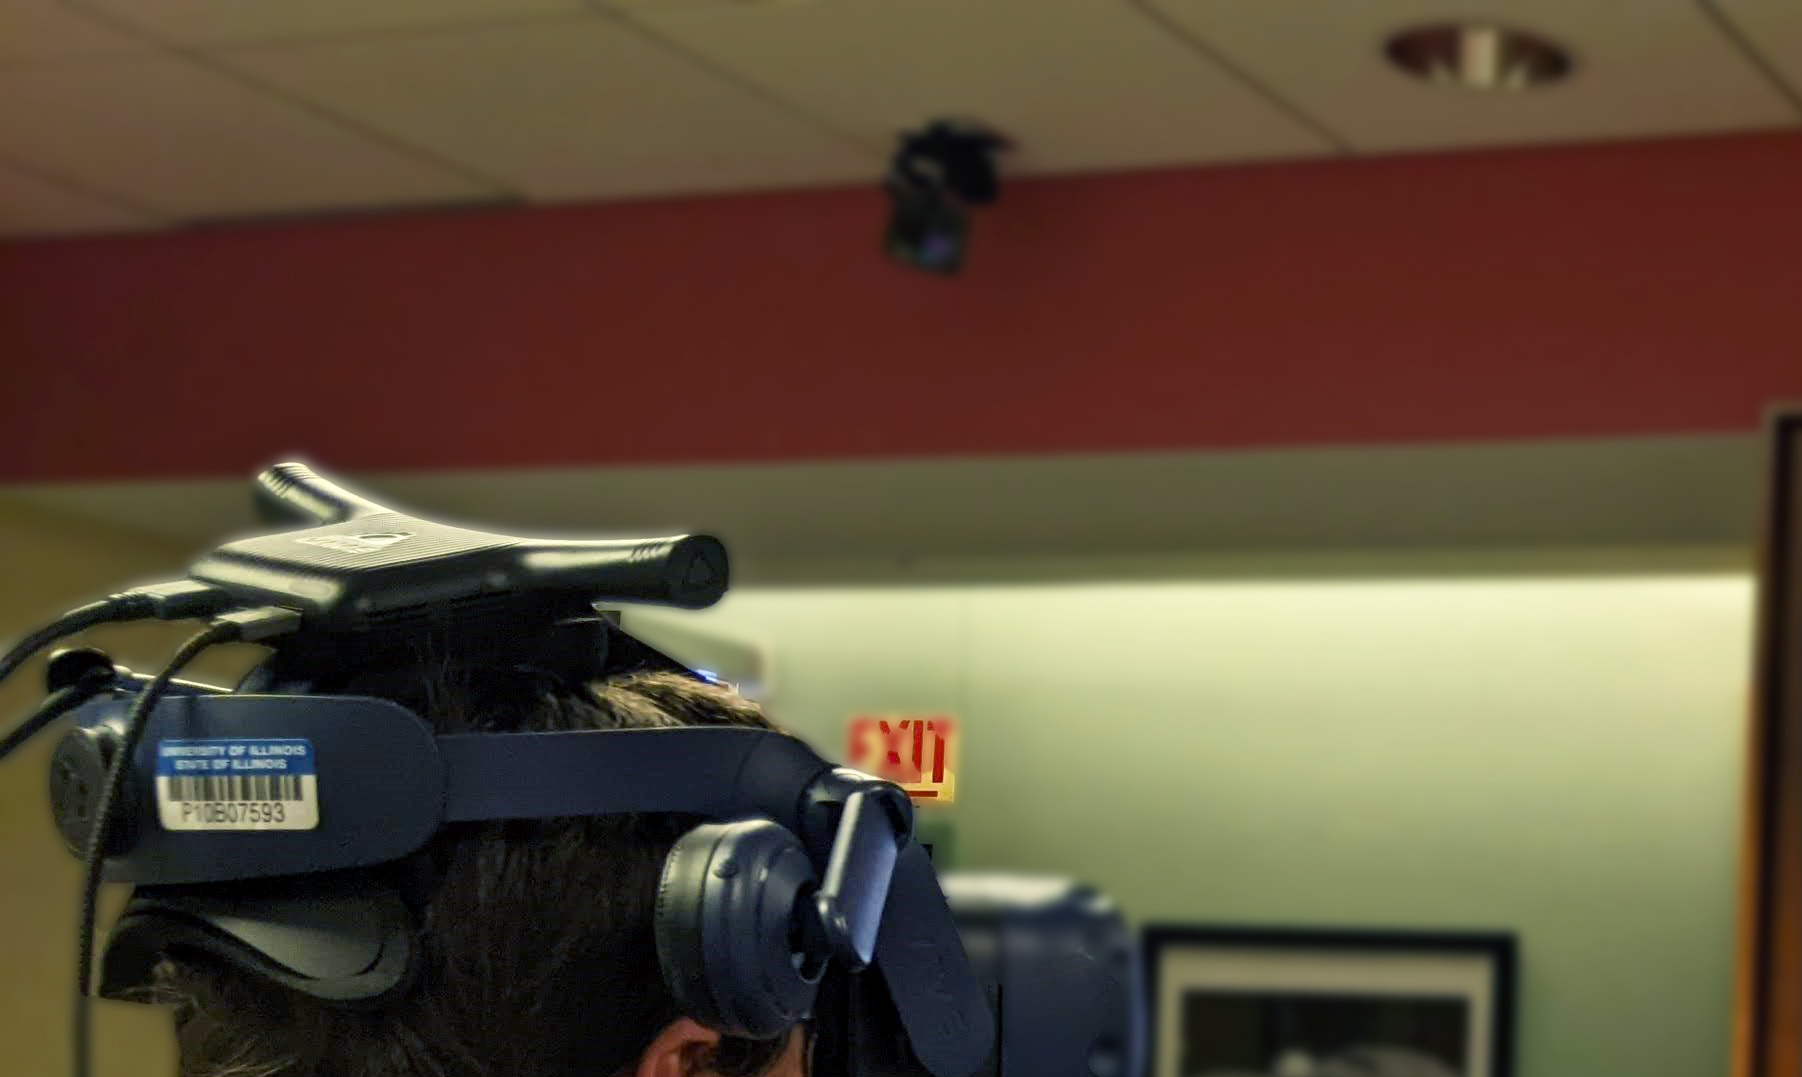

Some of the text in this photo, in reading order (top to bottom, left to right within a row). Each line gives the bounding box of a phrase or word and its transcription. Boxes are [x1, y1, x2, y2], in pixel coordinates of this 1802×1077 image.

[228, 745, 246, 756] OF
[248, 744, 306, 756] ILLINOIS
[175, 758, 288, 770] STATE OF ILLINOIS
[182, 802, 285, 823] P10B07593
